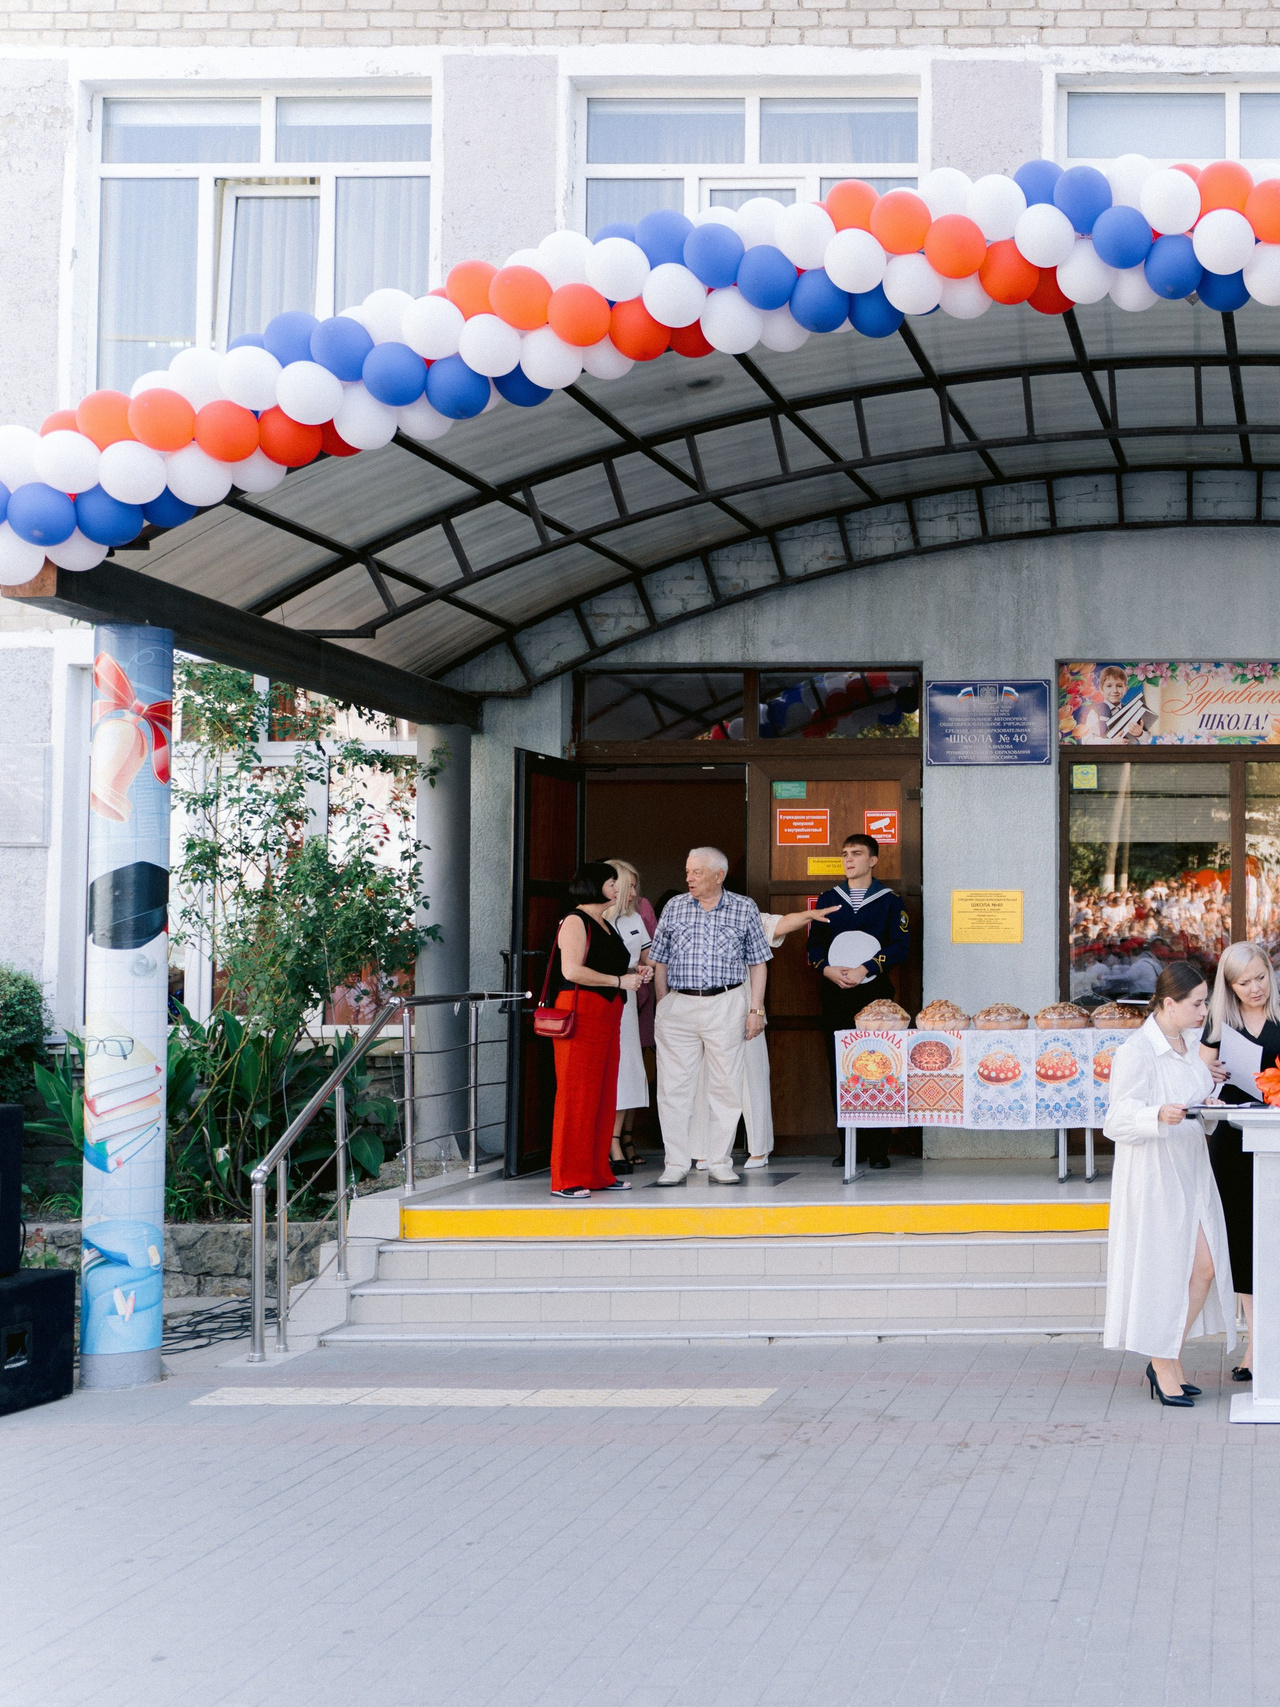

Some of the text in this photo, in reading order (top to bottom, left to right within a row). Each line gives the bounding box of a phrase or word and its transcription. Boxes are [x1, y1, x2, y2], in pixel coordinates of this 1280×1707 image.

[1198, 713, 1269, 730] ШКОЛА!
[949, 733, 1028, 743] ШКОЛА № 40
